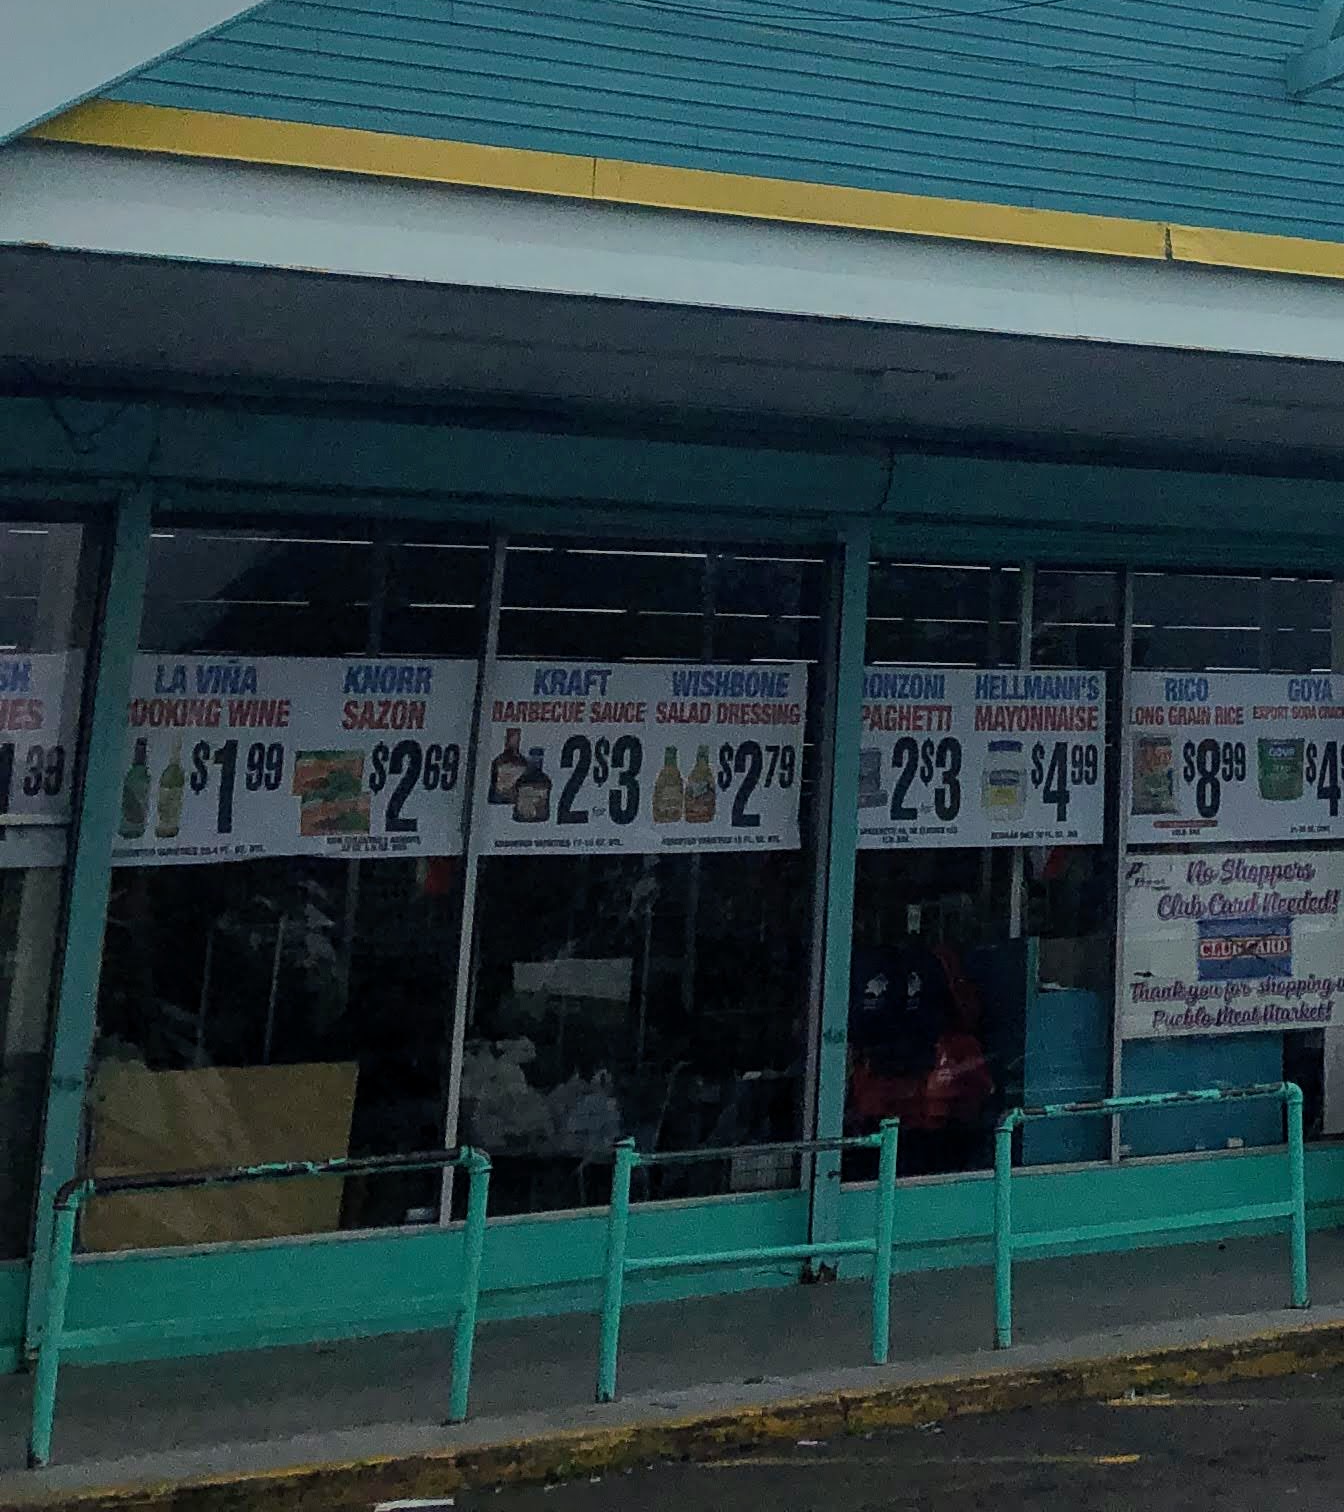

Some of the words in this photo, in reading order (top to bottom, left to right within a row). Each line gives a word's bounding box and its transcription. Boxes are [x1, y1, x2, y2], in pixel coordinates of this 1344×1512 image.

[155, 664, 186, 694] LA
[344, 665, 433, 694] KNORR
[533, 669, 612, 696] KRAFT
[672, 670, 790, 698] WISHBONE
[864, 674, 944, 699] ONZONI
[975, 675, 1099, 700] HELLMANN'S
[1165, 679, 1209, 702] RICO
[1288, 679, 1333, 701] GOYA
[128, 699, 221, 728] OOKING
[227, 699, 290, 728] WINE
[342, 701, 427, 729] SAZON
[492, 701, 586, 723] BARBECUE
[590, 701, 647, 723] SAUCE
[655, 702, 712, 724] SALAD
[716, 702, 801, 724] DRESSING
[863, 705, 952, 731] PAGHETTI
[974, 705, 1099, 731] MAYONNAISE
[1129, 707, 1164, 725] LONG
[1168, 707, 1212, 725] GRAIN
[1215, 707, 1244, 725] RICE
[1185, 859, 1217, 886] No
[1220, 858, 1315, 888] Shoppers
[1157, 891, 1205, 920] Club
[1208, 891, 1259, 916] Card
[1200, 940, 1243, 956] CLUB
[1244, 938, 1288, 954] CARD
[1130, 980, 1186, 1004] Thank
[1186, 982, 1220, 1005] you
[1222, 979, 1250, 1006] for
[1255, 974, 1334, 1000] shopping
[1152, 1005, 1215, 1029] Pueblo
[1215, 1004, 1262, 1027] Meat
[1262, 999, 1336, 1026] Market!
